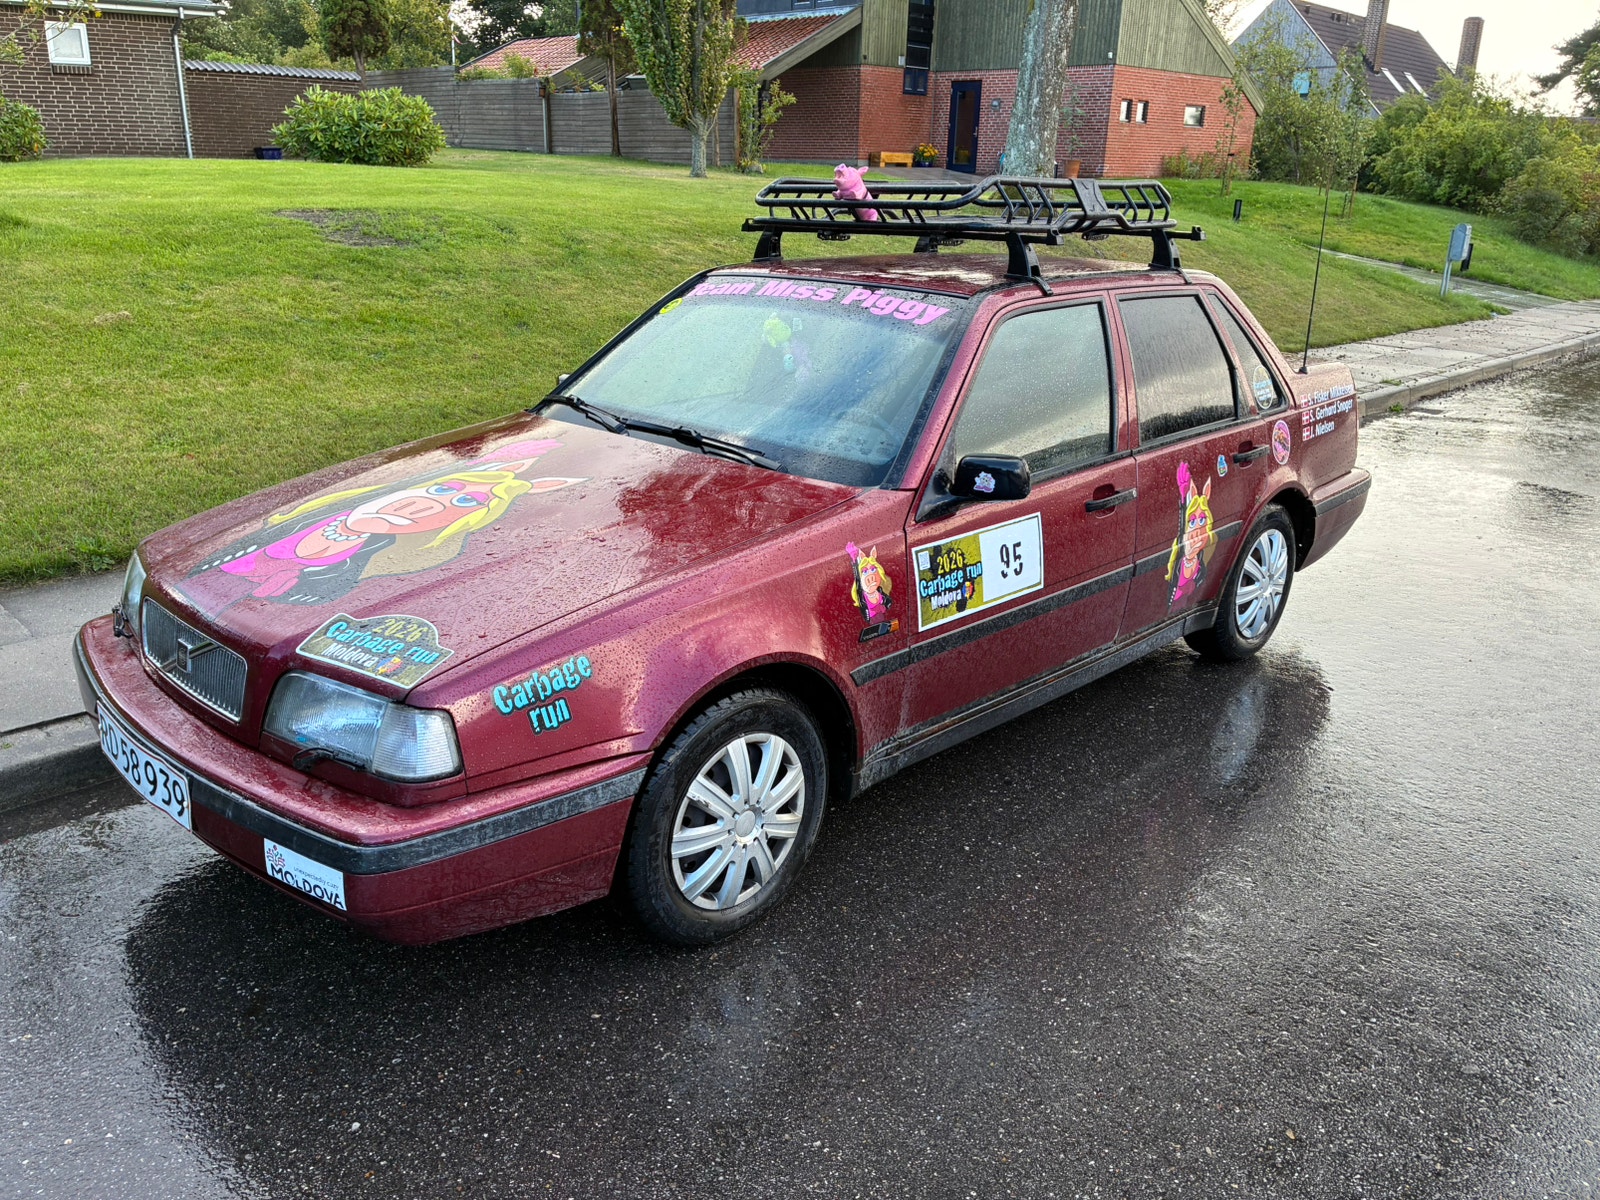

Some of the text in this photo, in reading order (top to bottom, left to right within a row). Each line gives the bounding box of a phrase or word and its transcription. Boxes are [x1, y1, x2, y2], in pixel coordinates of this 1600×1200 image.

[755, 280, 838, 301] Miss
[840, 287, 951, 326] Piggy
[1316, 400, 1337, 420] Gerhard
[1315, 421, 1335, 437] Nielsen
[937, 549, 964, 575] 2026
[1000, 541, 1023, 579] 95
[920, 562, 983, 598] Carbage run
[931, 589, 961, 610] Moldova
[326, 621, 440, 664] Carbage run
[372, 618, 428, 642] 2026
[321, 642, 379, 667] Moldova
[493, 655, 592, 714] Carbage
[529, 698, 571, 733] run
[100, 713, 186, 817] RD 58 939
[270, 862, 345, 909] MOLDOVA
